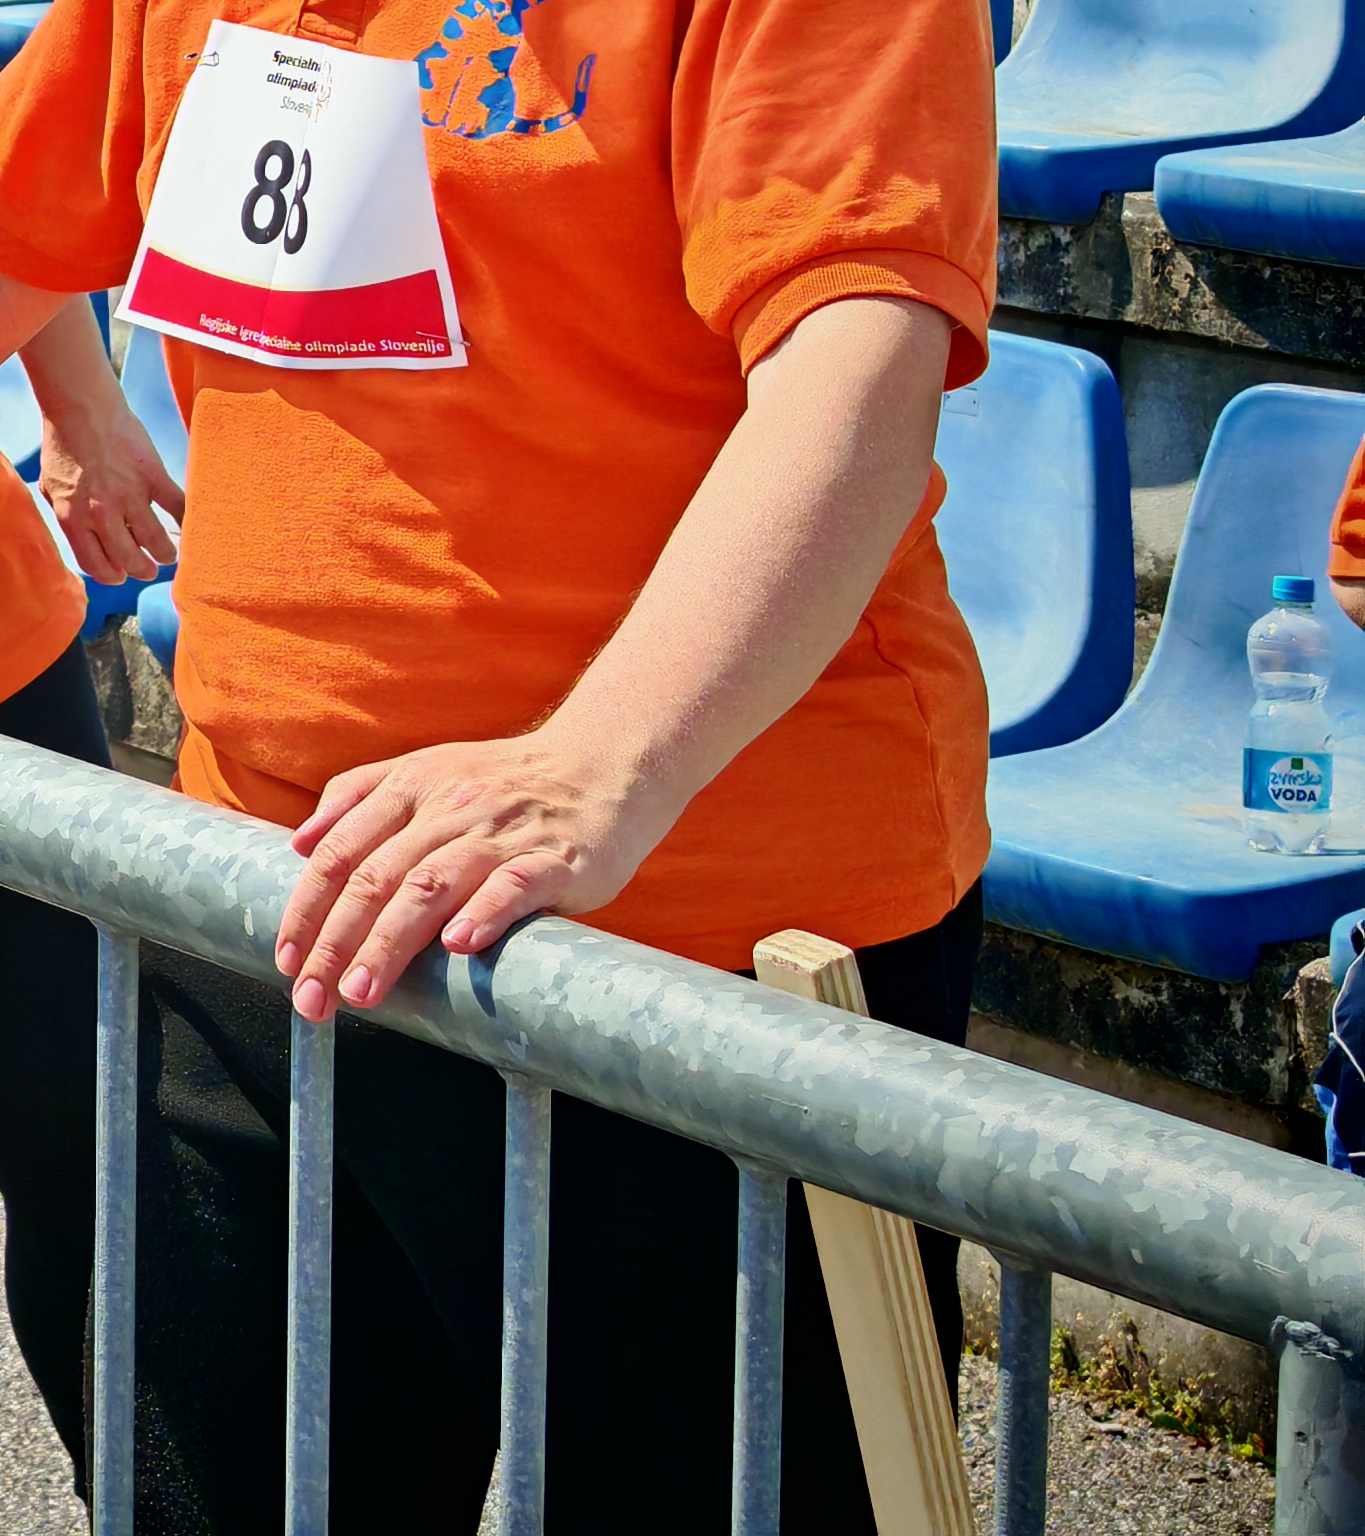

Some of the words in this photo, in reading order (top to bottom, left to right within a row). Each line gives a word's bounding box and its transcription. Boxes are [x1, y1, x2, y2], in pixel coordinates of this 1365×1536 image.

[266, 72, 317, 93] olimpiad
[241, 140, 312, 254] 88
[304, 339, 376, 355] olimpiade
[380, 338, 446, 355] Slovenije
[1270, 787, 1317, 802] VODA
